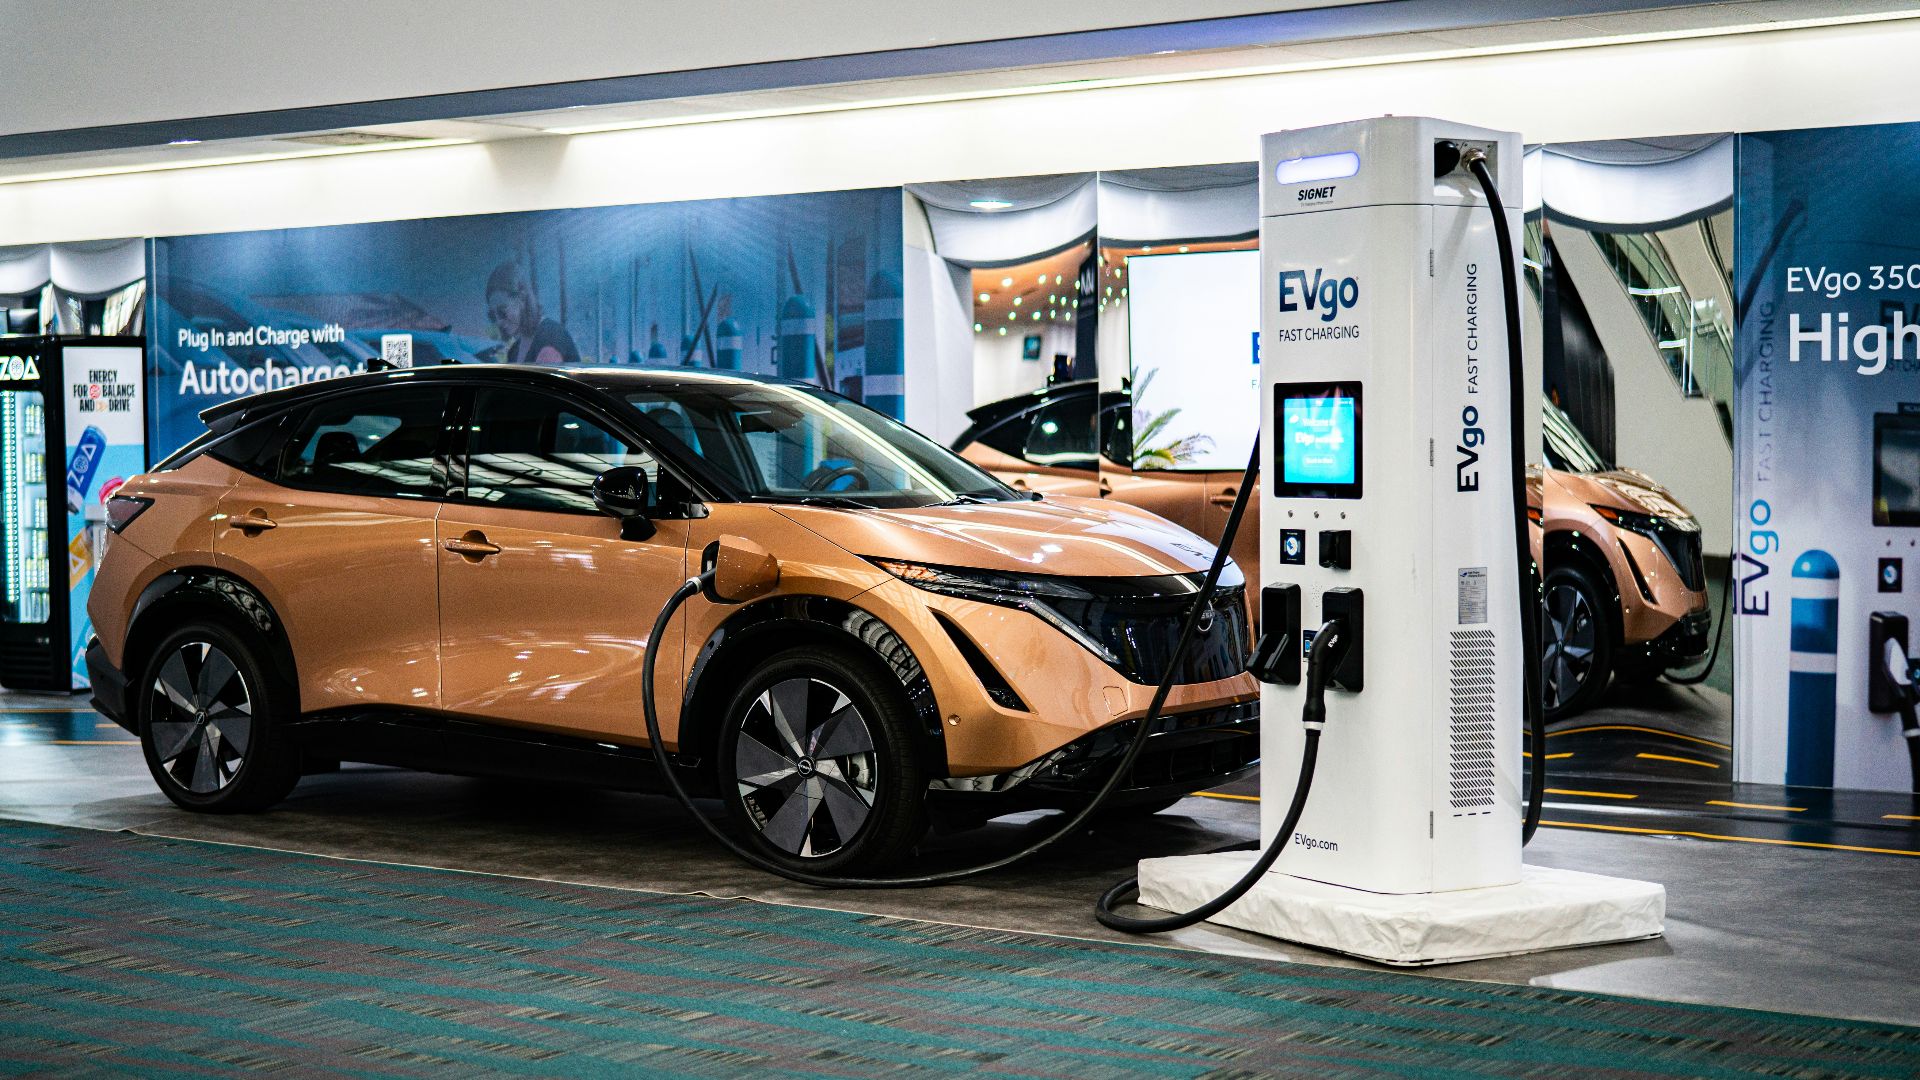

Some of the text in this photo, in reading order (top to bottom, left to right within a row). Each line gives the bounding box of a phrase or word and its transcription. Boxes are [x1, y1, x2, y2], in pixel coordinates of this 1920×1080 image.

[1297, 186, 1336, 201] SIGNET
[1279, 268, 1359, 322] EVgo
[1787, 264, 1920, 298] EVgo 350
[178, 323, 345, 352] Plug In and Charge with
[1279, 325, 1360, 342] FAST CHARGING
[1466, 263, 1478, 394] FAST CHARGING
[1789, 311, 1920, 376] High
[73, 384, 135, 398] FOR BALANCE
[89, 370, 117, 383] ENERGY
[1757, 301, 1775, 482] FAST CHARGING
[80, 399, 130, 412] AND DRIVE
[1457, 405, 1485, 493] EVgo
[1741, 498, 1779, 616] EVgo
[1295, 833, 1338, 851] EVgo.com
